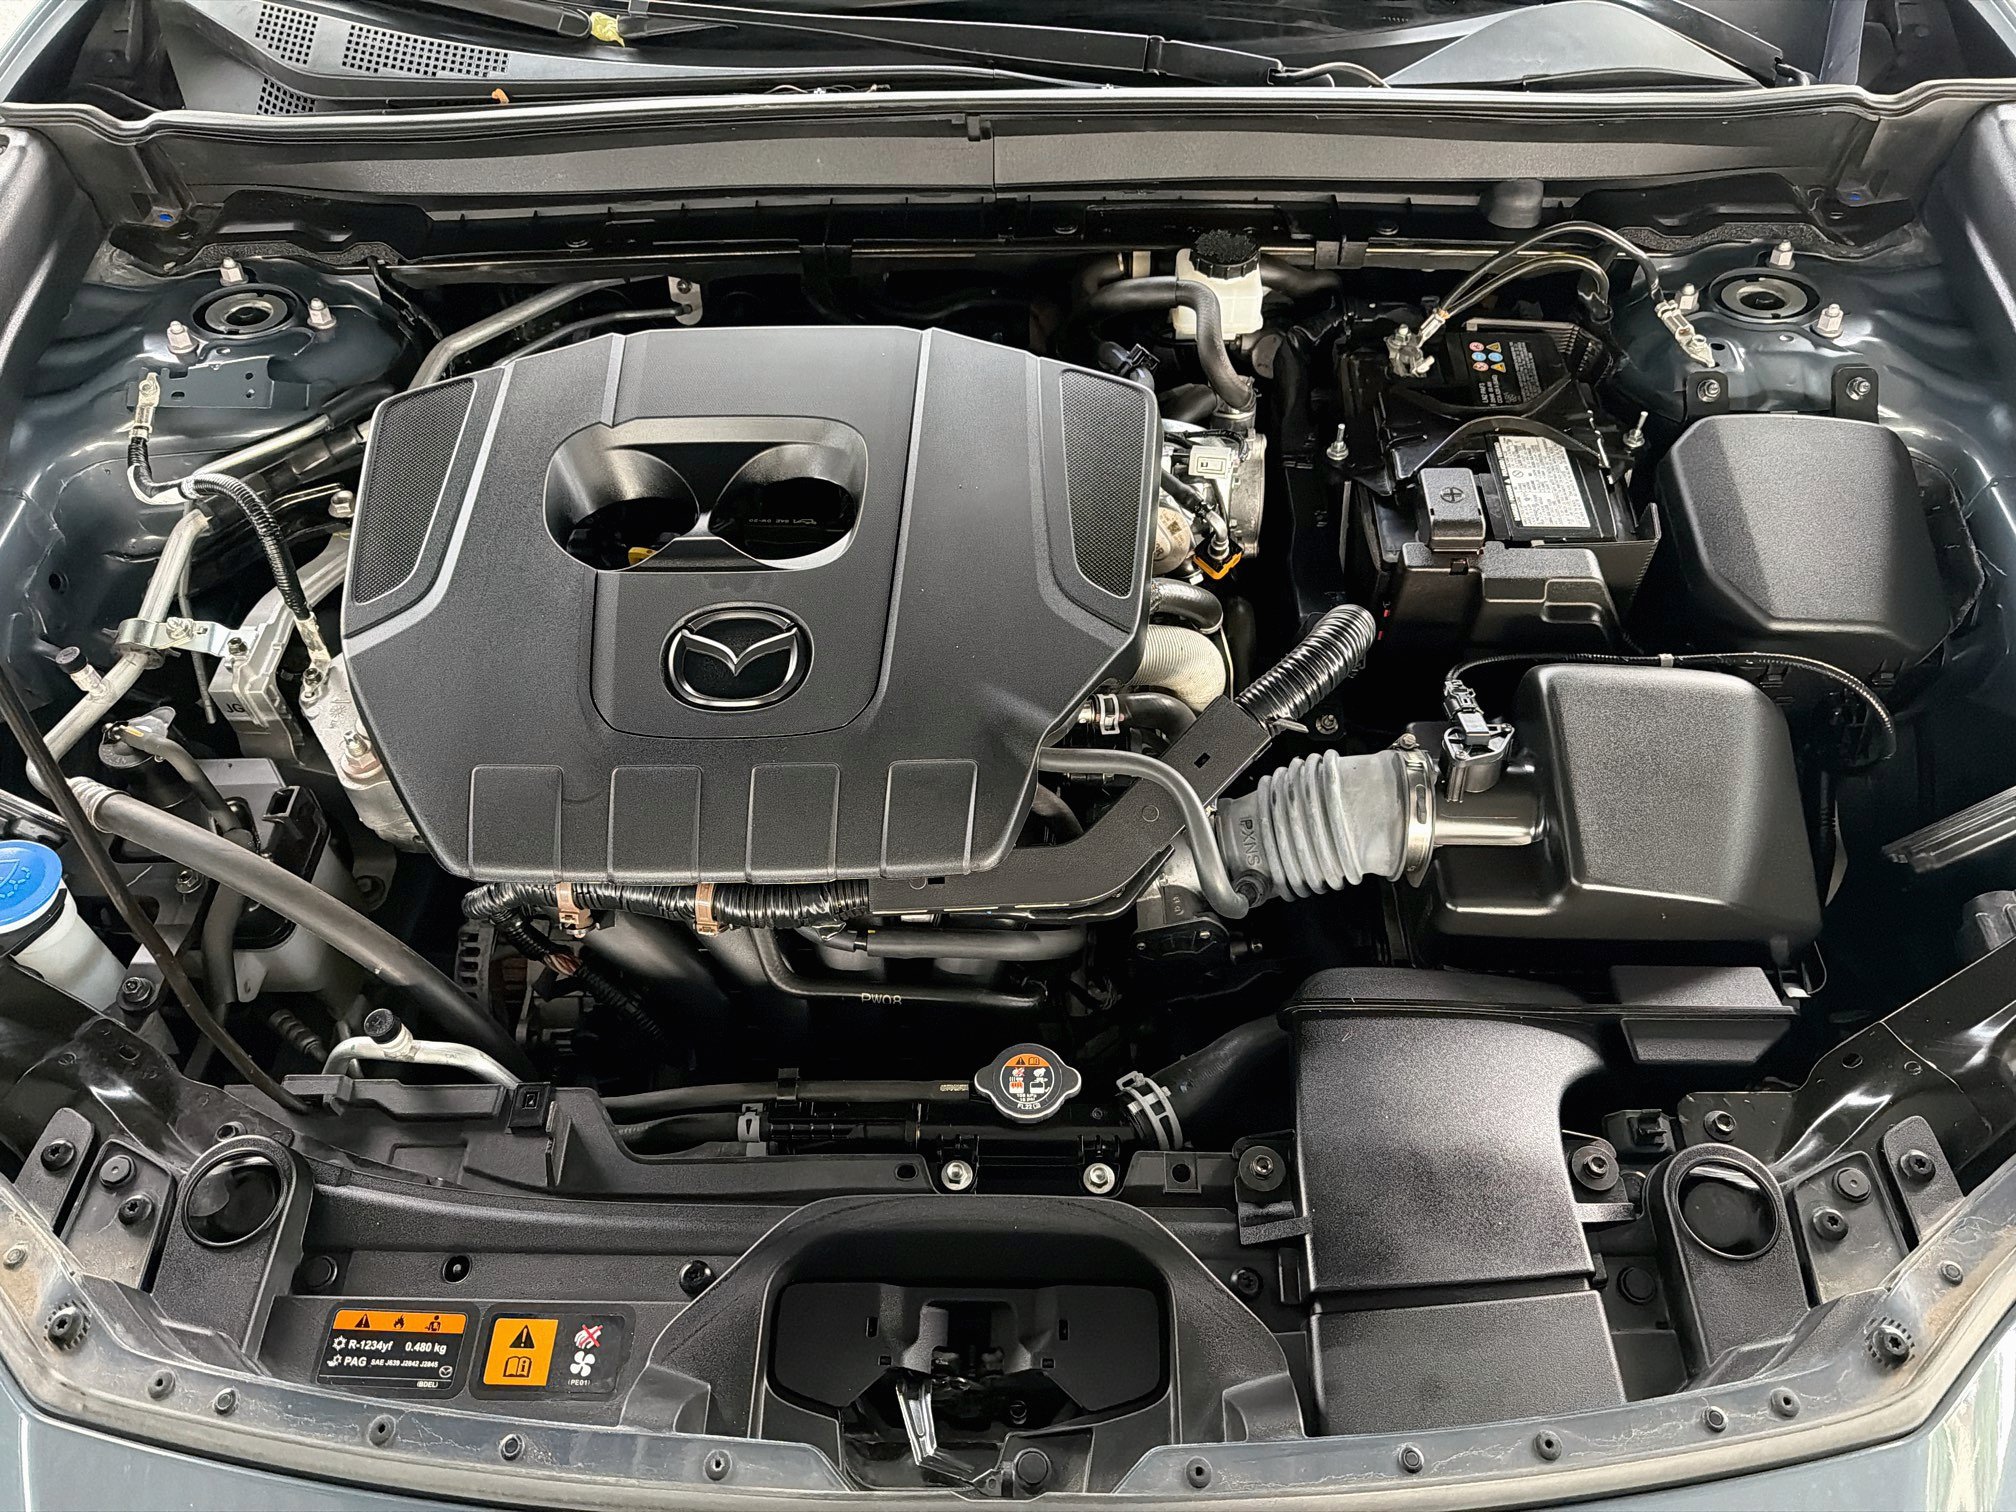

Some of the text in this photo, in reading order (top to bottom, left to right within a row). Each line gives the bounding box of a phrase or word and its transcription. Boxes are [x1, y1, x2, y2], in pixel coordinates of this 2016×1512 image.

[348, 1339, 447, 1355] R-1234yf 0.480 kg
[343, 1357, 367, 1367] PAG
[371, 1358, 385, 1366] SAE
